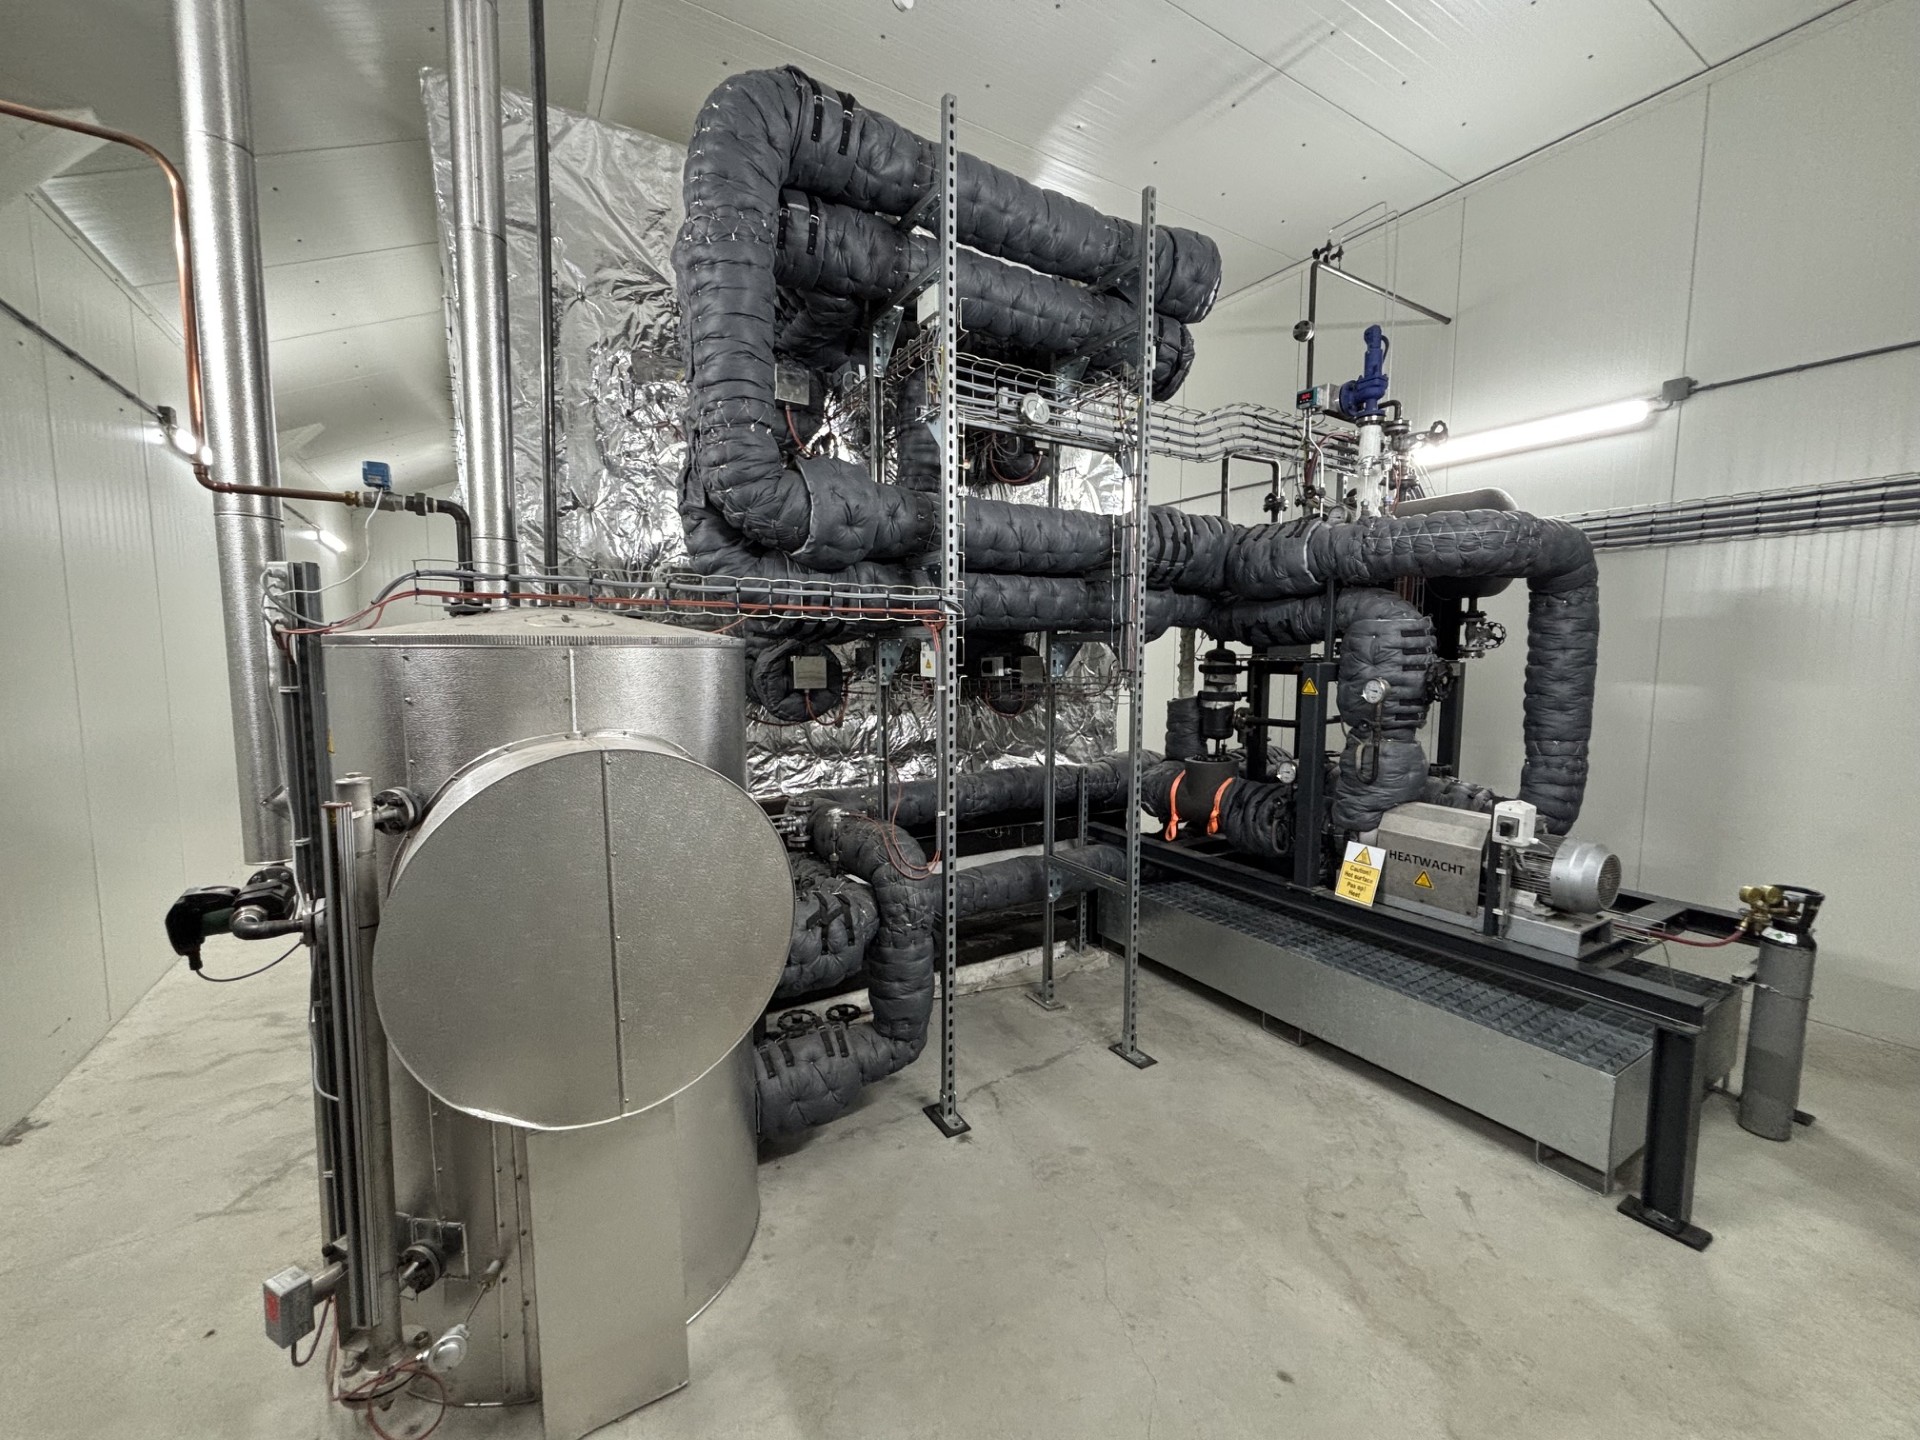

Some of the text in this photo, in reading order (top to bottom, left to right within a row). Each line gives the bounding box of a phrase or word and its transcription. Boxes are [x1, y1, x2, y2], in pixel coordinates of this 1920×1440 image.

[1389, 849, 1465, 875] HEATWACHT
[1354, 874, 1373, 883] surface
[1347, 881, 1356, 889] Pas
